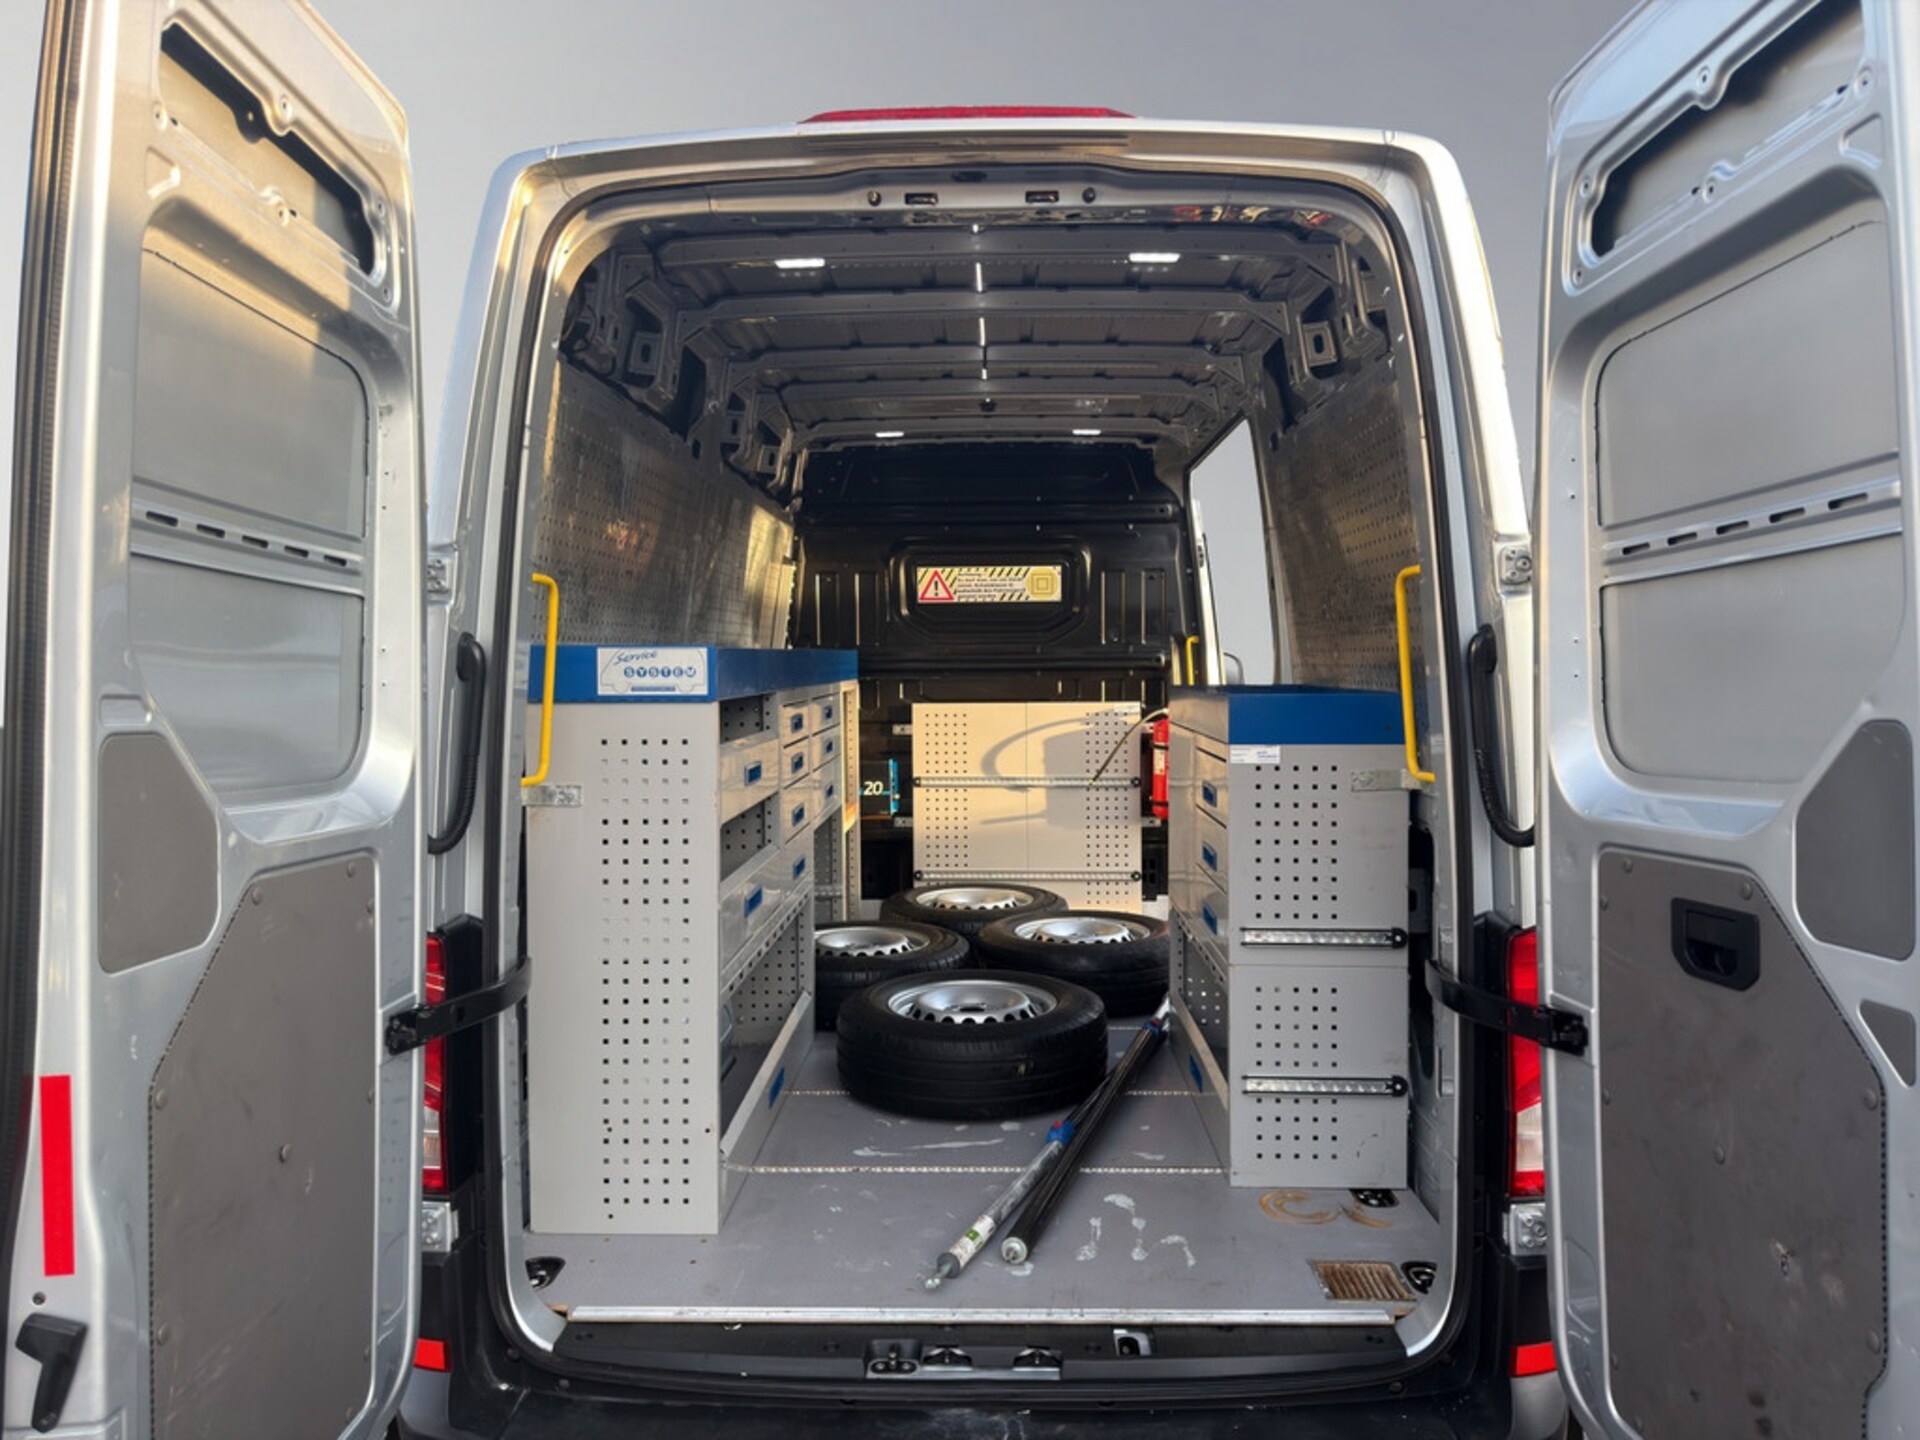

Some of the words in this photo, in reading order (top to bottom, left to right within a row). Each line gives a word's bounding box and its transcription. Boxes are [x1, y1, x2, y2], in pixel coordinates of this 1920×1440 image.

[614, 651, 657, 665] Service
[623, 666, 697, 678] SYSTEM
[863, 781, 884, 796] 20
